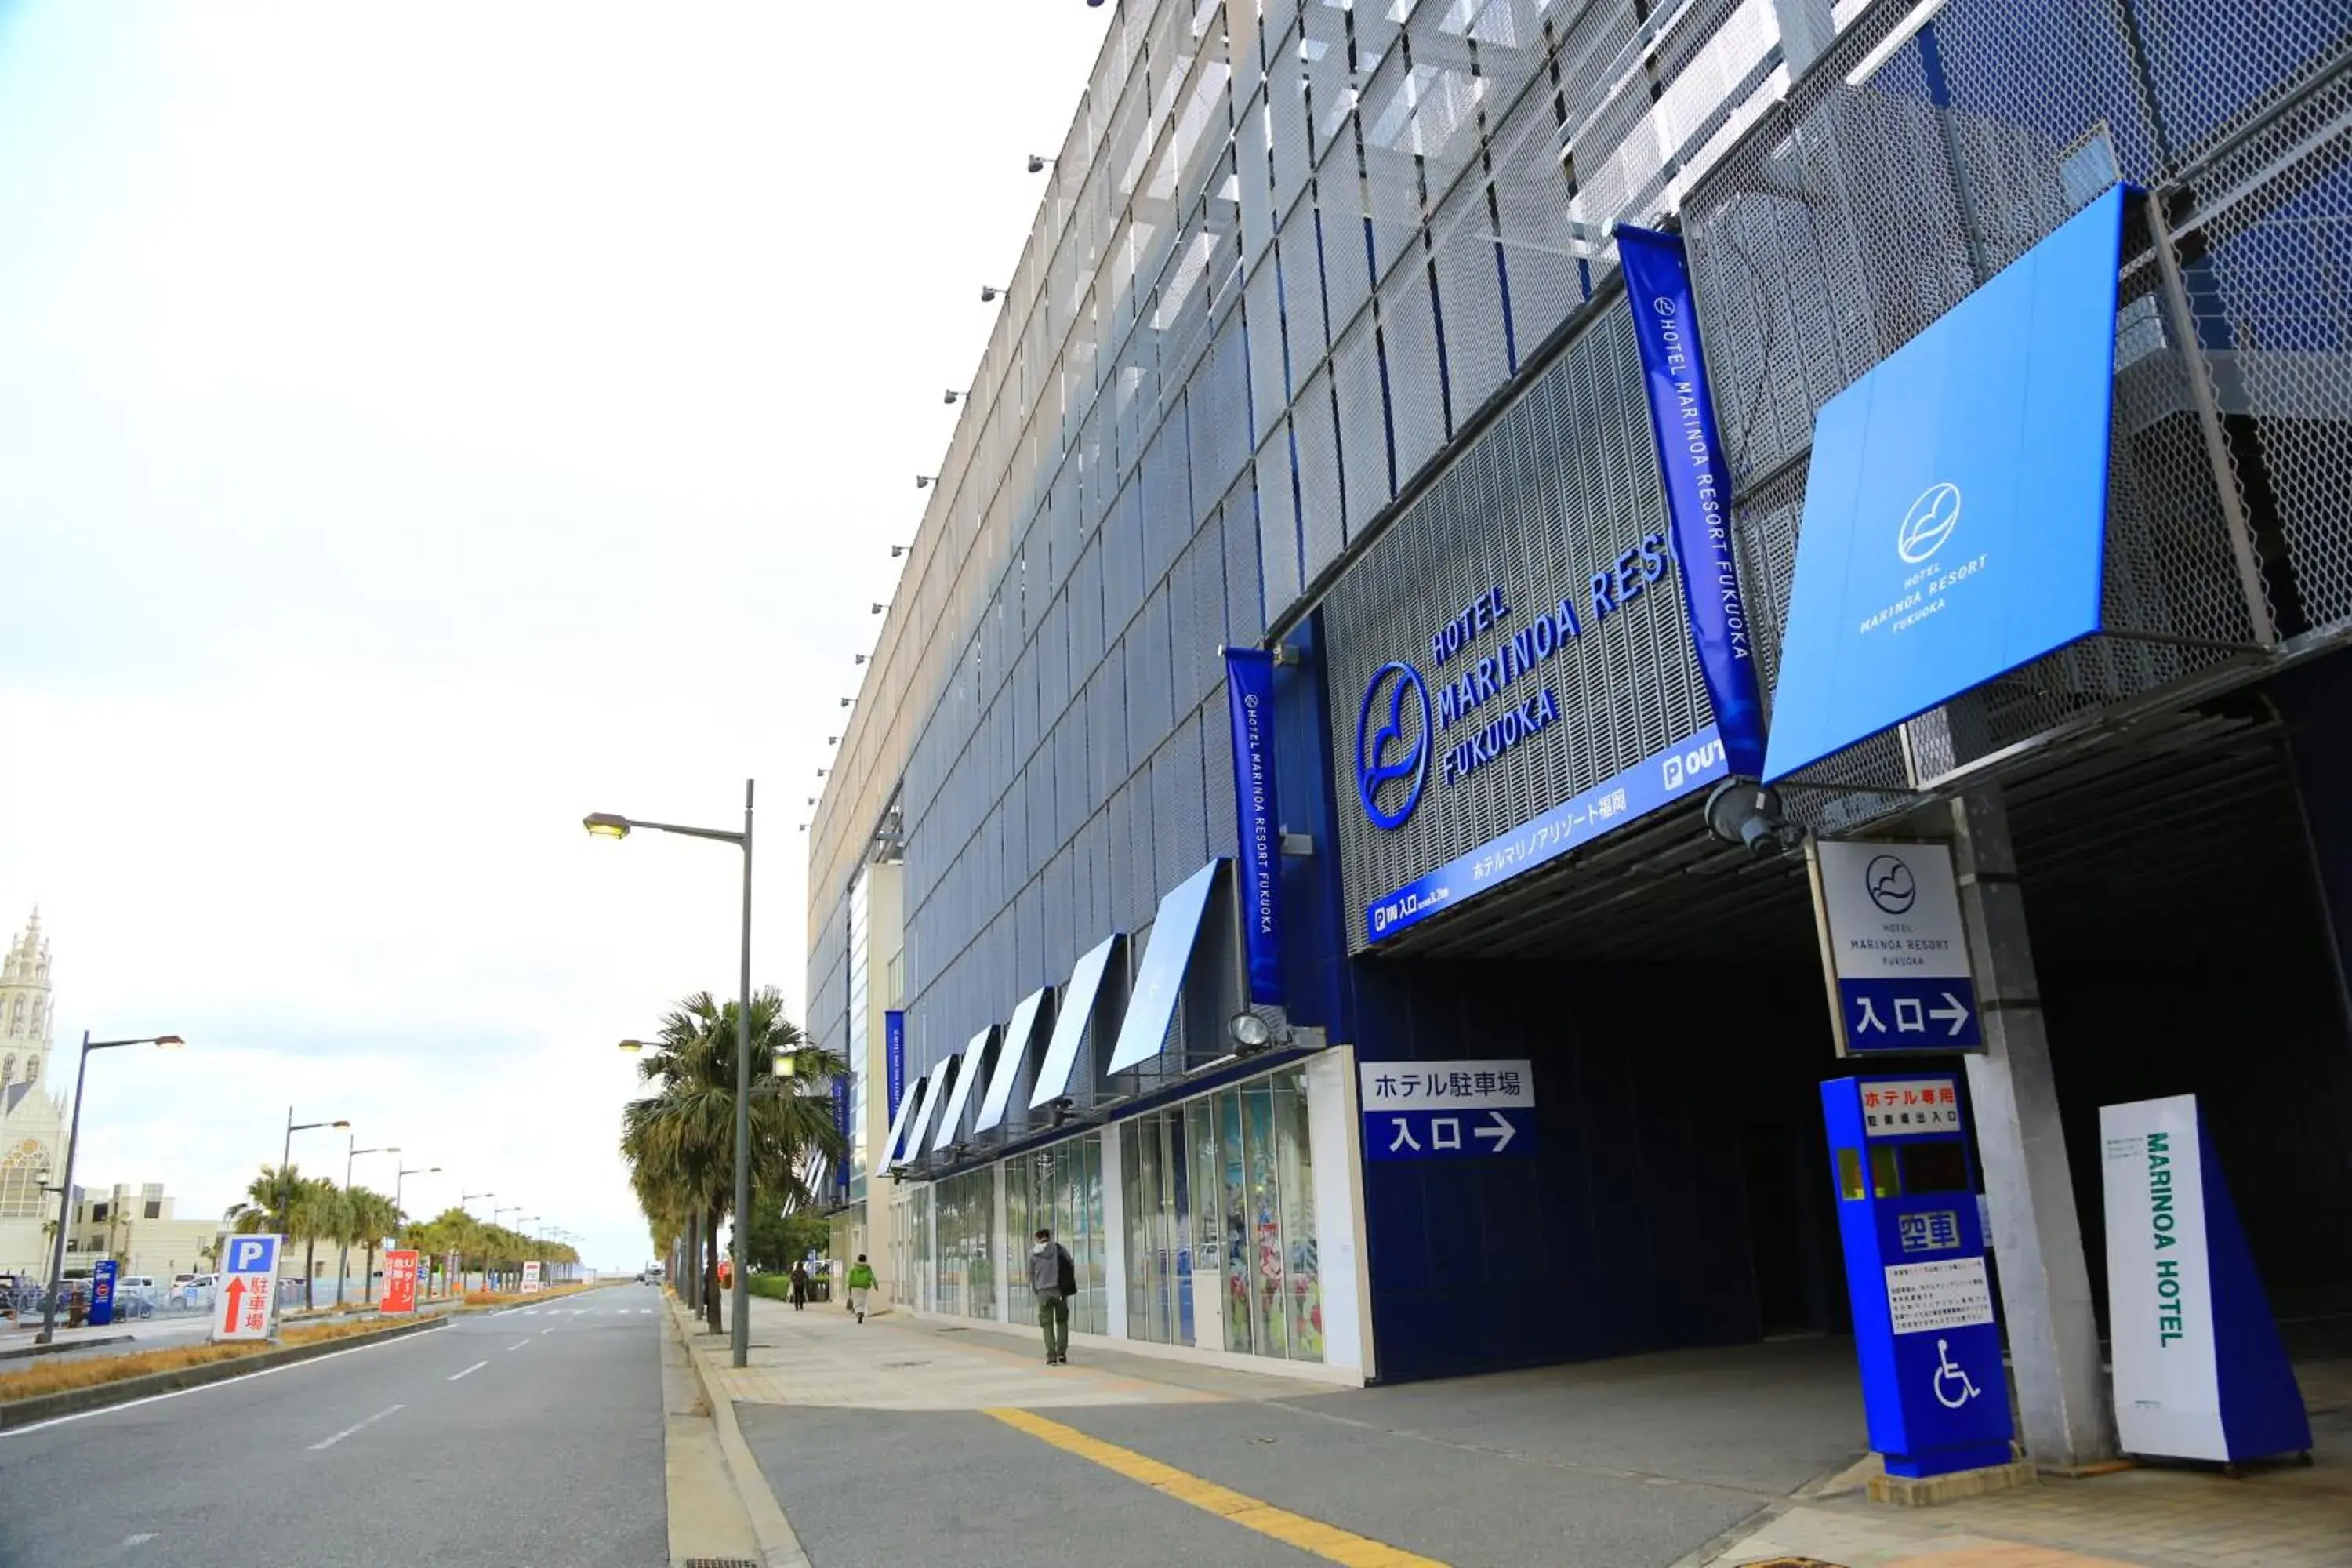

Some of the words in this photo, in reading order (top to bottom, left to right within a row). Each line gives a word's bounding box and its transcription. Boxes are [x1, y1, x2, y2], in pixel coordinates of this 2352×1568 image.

[1661, 319, 1686, 376] HOTEL
[1675, 381, 1708, 466] MARINOA
[1696, 474, 1727, 553] RESORT
[1715, 561, 1748, 659] FUKUOKA
[1860, 590, 1922, 634] MARINOA
[1929, 554, 1987, 596] RESORT
[1904, 562, 1941, 590] HOTEL
[1432, 586, 1510, 666] HOTEL
[1438, 597, 1581, 730] MARINOA
[1590, 526, 1677, 622] RES
[1892, 598, 1945, 634] FUKUOKA
[1247, 709, 1258, 749] HOTEL
[1443, 688, 1559, 785] FUKUOKA
[1251, 753, 1265, 811] MARINOA
[1254, 817, 1269, 866] RESORT
[1258, 872, 1271, 934] FUKUOKA
[1850, 940, 1903, 951] MARINOA
[1907, 940, 1950, 951] RESORT
[1856, 996, 1926, 1034] 入口
[1375, 1071, 1521, 1098] ホテル駐車場
[1865, 1087, 1954, 1108] ホテル専用
[1389, 1117, 1461, 1152] 入口
[2147, 1132, 2176, 1250] MARINOA
[1900, 1211, 1956, 1250] 空車
[238, 1242, 263, 1269] P
[245, 1277, 269, 1330] 駐車場
[2156, 1260, 2183, 1348] HOTEL
